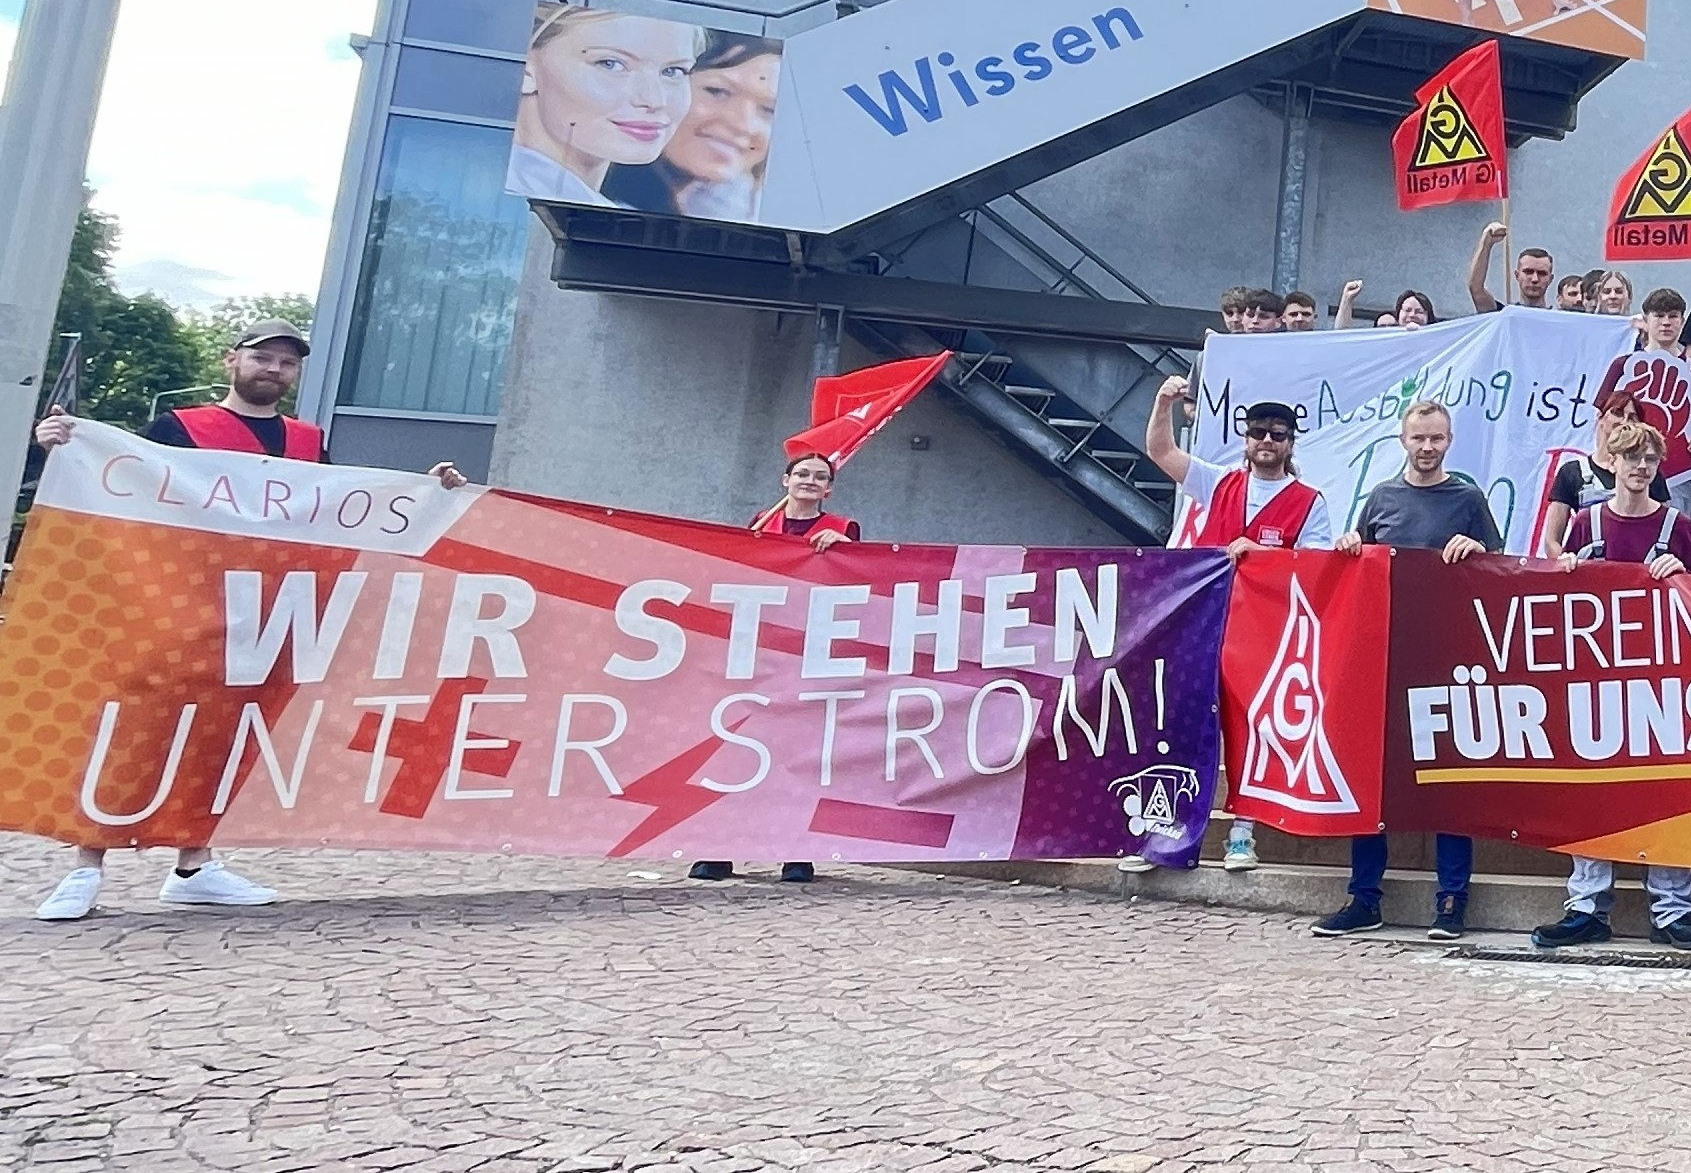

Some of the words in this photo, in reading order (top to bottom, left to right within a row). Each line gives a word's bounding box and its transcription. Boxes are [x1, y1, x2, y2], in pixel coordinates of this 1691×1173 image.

[843, 4, 1145, 137] Wissen
[1194, 378, 1310, 445] Mee
[1527, 373, 1592, 429] ist
[101, 453, 418, 534] CLARIOS
[224, 569, 537, 686] WIR
[603, 563, 1119, 682] STEHEN
[79, 692, 628, 827] UNTER
[700, 658, 1170, 795] STROM!
[1407, 663, 1555, 762] FÜR
